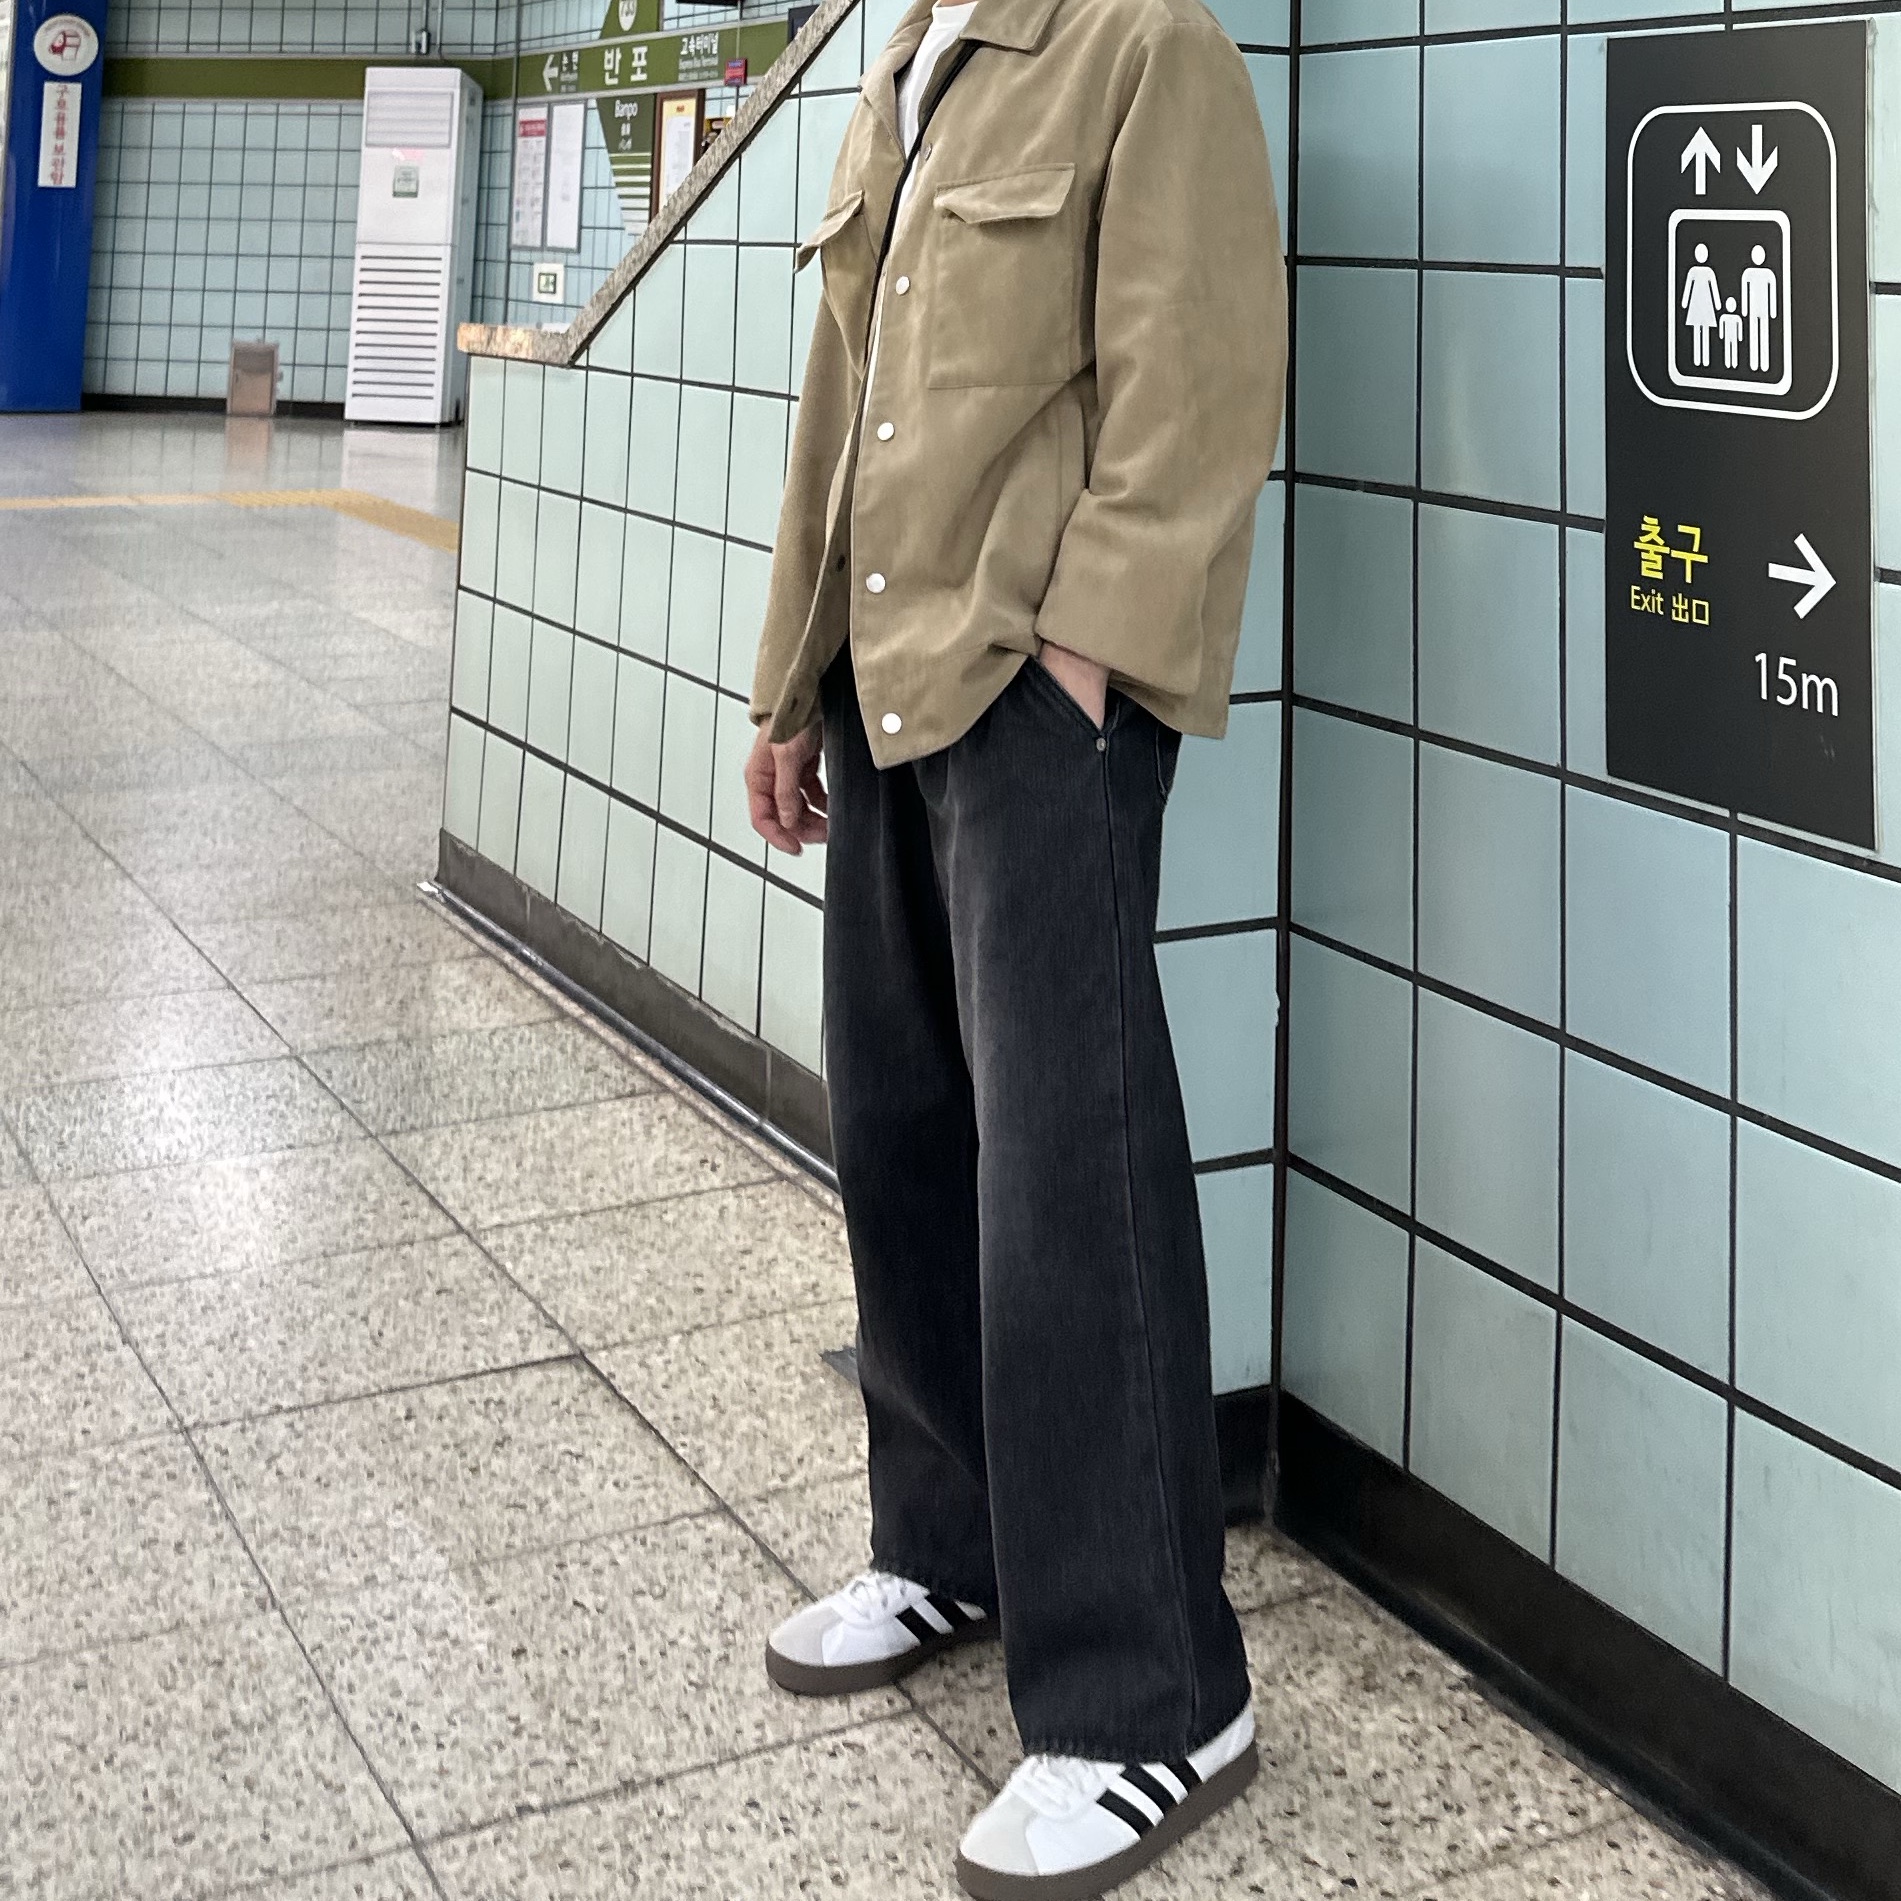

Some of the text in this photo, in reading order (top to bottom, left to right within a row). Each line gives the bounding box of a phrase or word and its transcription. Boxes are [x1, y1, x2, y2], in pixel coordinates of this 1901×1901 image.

[615, 100, 638, 120] Banpo
[1633, 515, 1709, 584] 출구
[1630, 585, 1710, 626] Exit 出口
[1754, 652, 1839, 717] 15m
